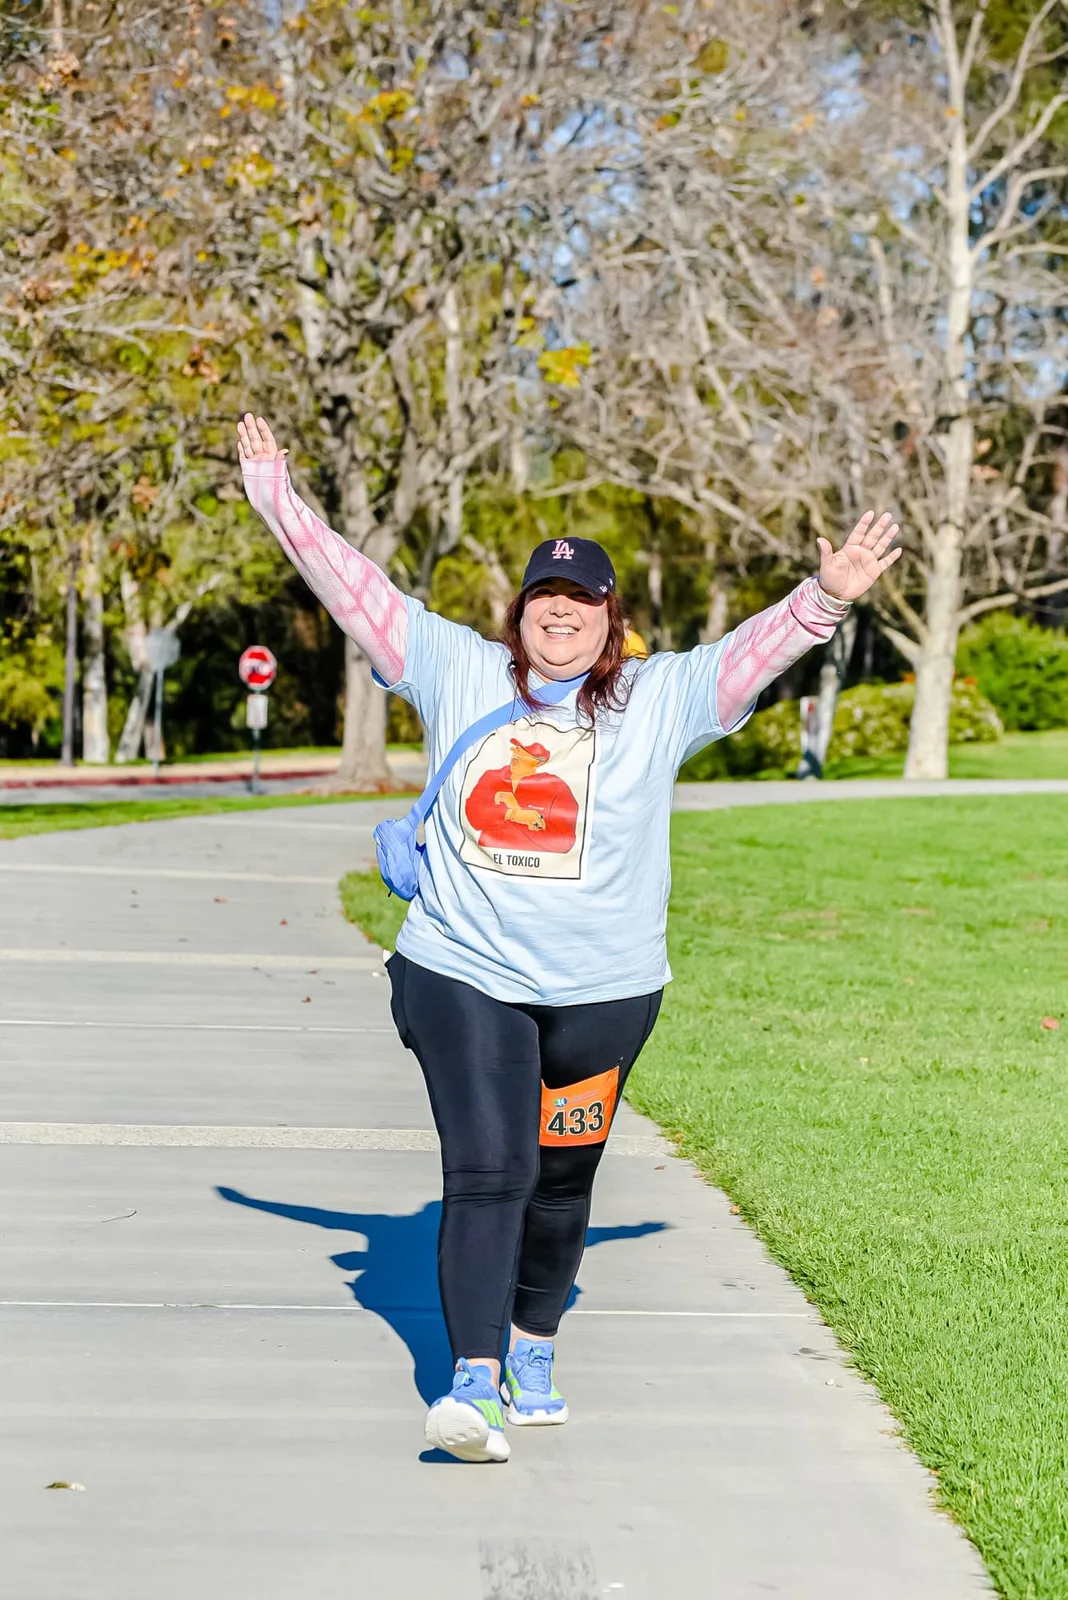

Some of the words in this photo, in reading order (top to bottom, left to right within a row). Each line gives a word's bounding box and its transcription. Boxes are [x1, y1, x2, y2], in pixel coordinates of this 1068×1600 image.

[552, 540, 574, 559] LA
[493, 853, 504, 865] EL
[507, 854, 541, 868] TOXICO
[548, 1102, 604, 1136] 433
